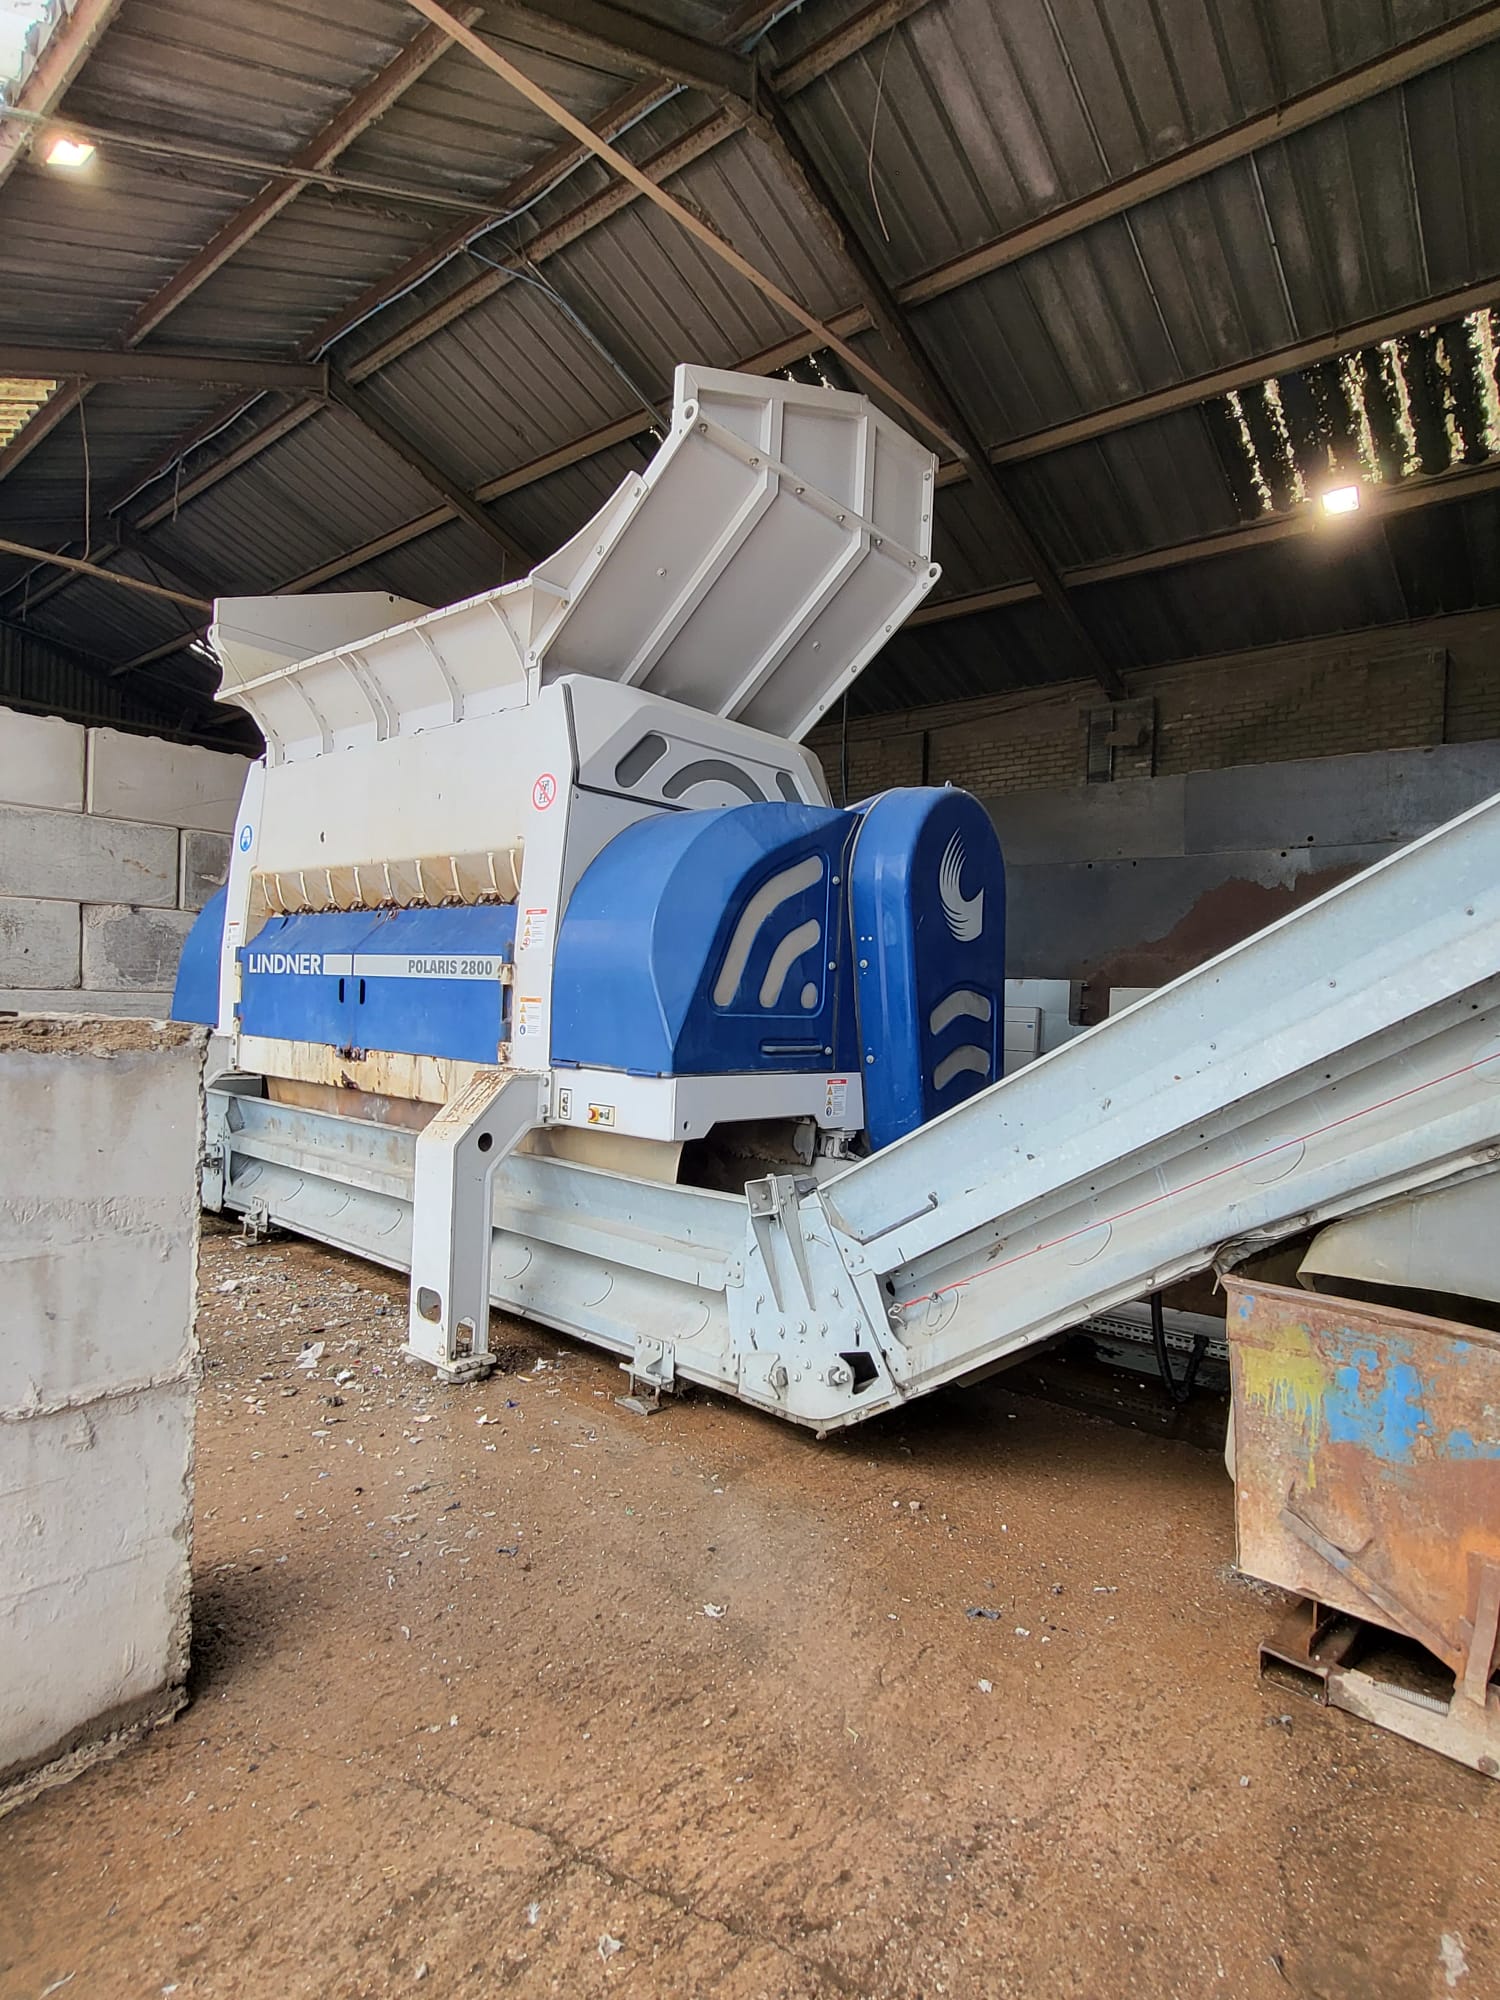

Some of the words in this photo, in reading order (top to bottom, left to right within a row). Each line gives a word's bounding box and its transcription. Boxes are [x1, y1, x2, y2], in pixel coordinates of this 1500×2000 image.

[249, 953, 321, 975] LINDNER
[408, 959, 457, 975] POLARIS
[461, 960, 493, 976] 2800
